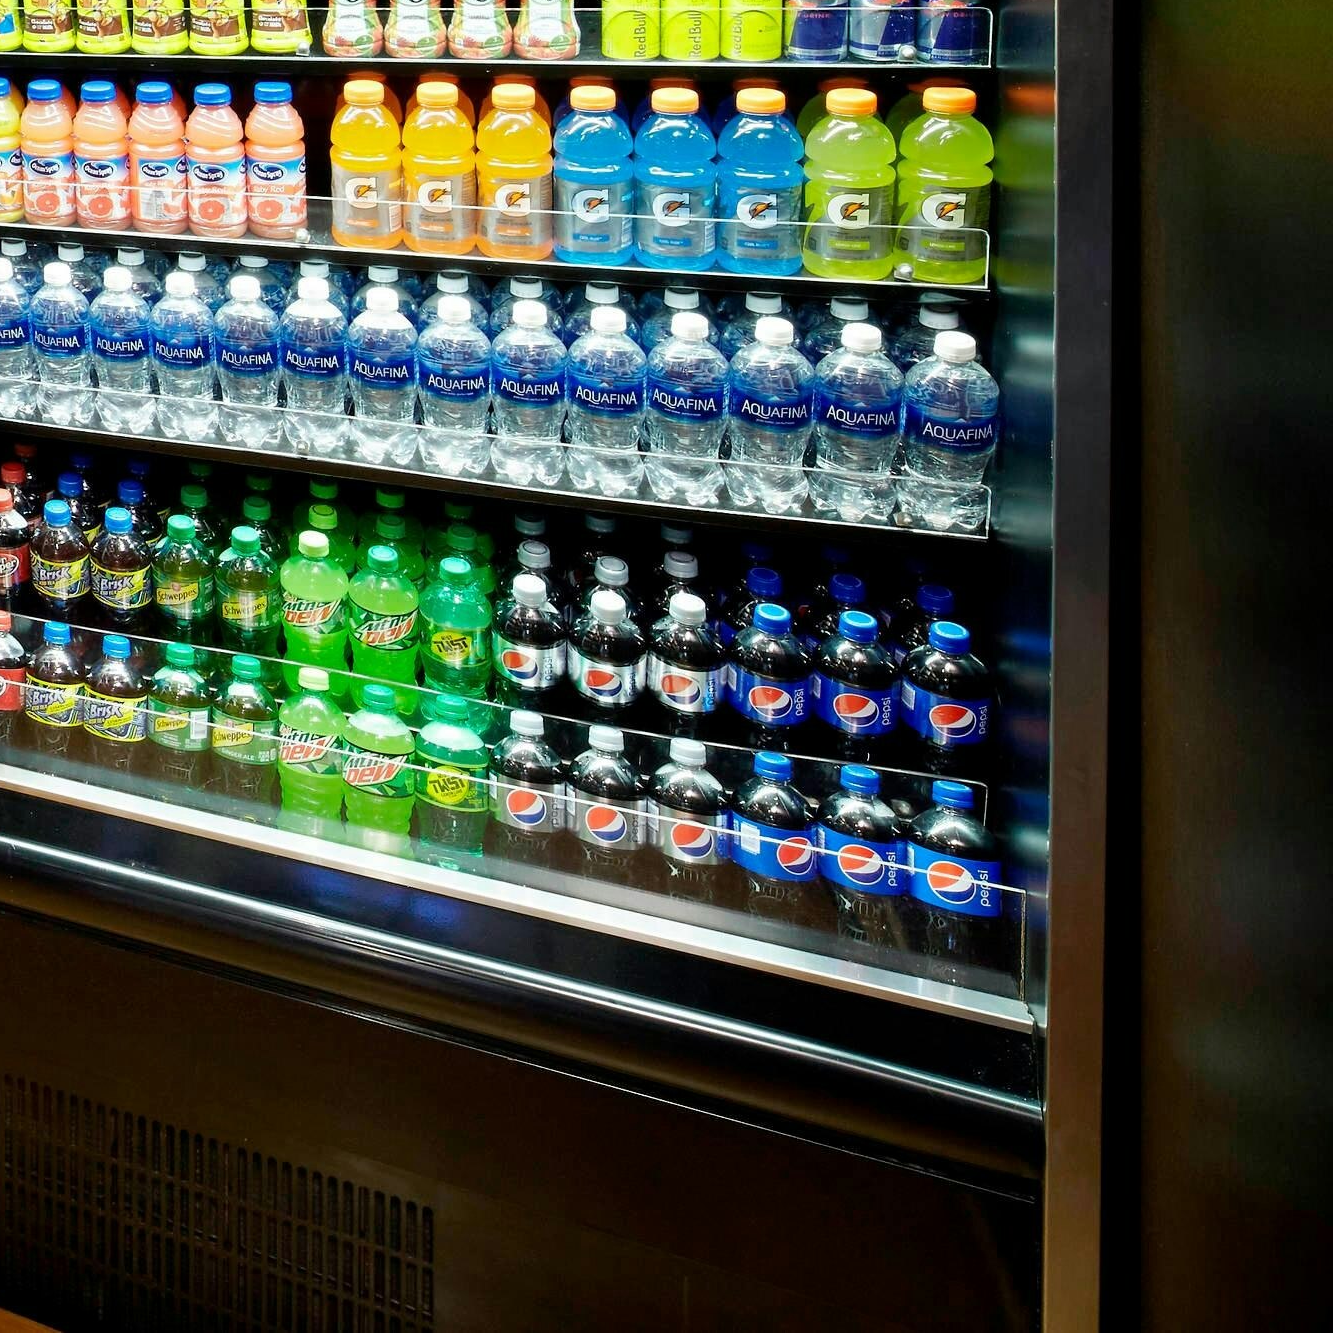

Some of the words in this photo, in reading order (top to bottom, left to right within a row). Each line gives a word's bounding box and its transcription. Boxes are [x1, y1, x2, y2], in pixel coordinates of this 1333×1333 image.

[345, 177, 378, 209] G
[418, 180, 453, 214] G
[494, 183, 531, 218] G
[571, 188, 611, 224] G
[652, 190, 692, 227] G
[735, 193, 780, 229] G
[826, 192, 871, 230] G
[921, 193, 967, 230] G
[33, 329, 81, 349] AQUAFINA
[95, 335, 146, 353] AQUAFINA
[154, 341, 205, 360] AQUAFINA
[220, 349, 274, 367] AQUAFINA
[285, 349, 340, 370] AQUAFINA
[353, 358, 409, 380] AQUAFINA
[427, 372, 486, 393] AQUAFINA
[499, 376, 561, 398] AQUAFINA
[574, 386, 638, 407] AQUAFINA
[651, 387, 718, 412] AQUAFINA
[740, 398, 809, 421] AQUAFINA
[825, 404, 897, 427] AQUAFINA
[921, 421, 995, 442] AQUAFINA
[156, 587, 199, 602] Schweppes
[794, 686, 805, 717] pepsi
